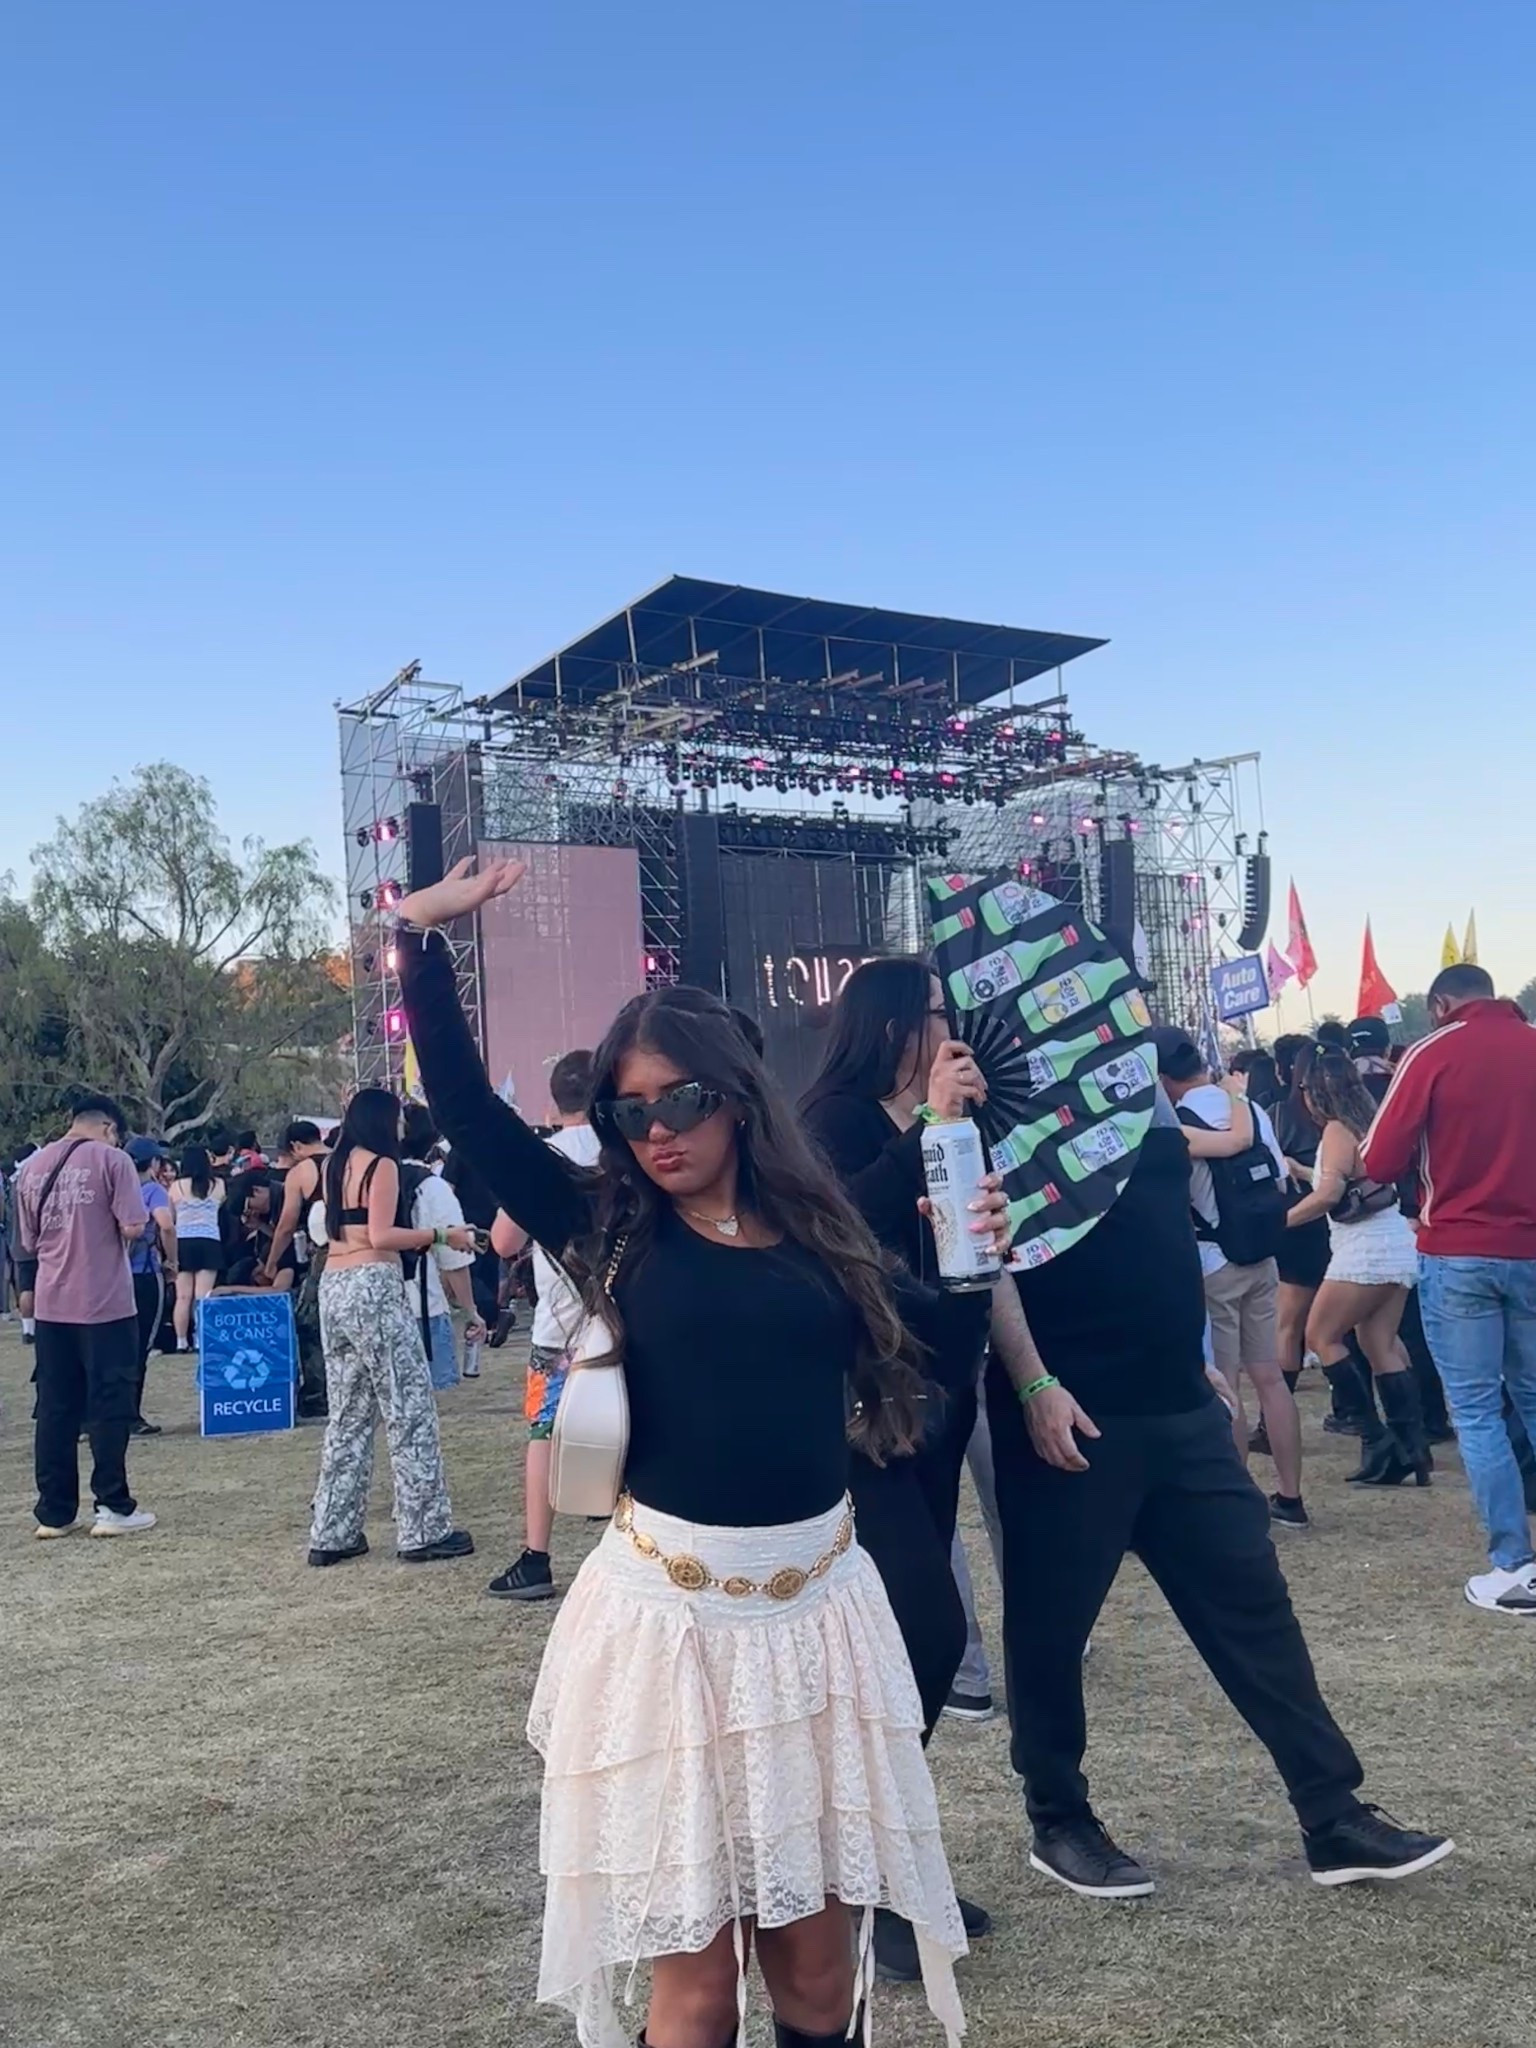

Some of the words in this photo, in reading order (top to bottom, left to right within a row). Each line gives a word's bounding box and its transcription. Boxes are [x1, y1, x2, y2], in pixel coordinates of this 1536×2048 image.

[1221, 967, 1257, 991] Auto
[1224, 986, 1260, 1010] Care
[214, 1311, 279, 1327] BOTTLES
[219, 1329, 230, 1342] &
[233, 1326, 275, 1340] CANS
[213, 1398, 283, 1416] RECYCLE
